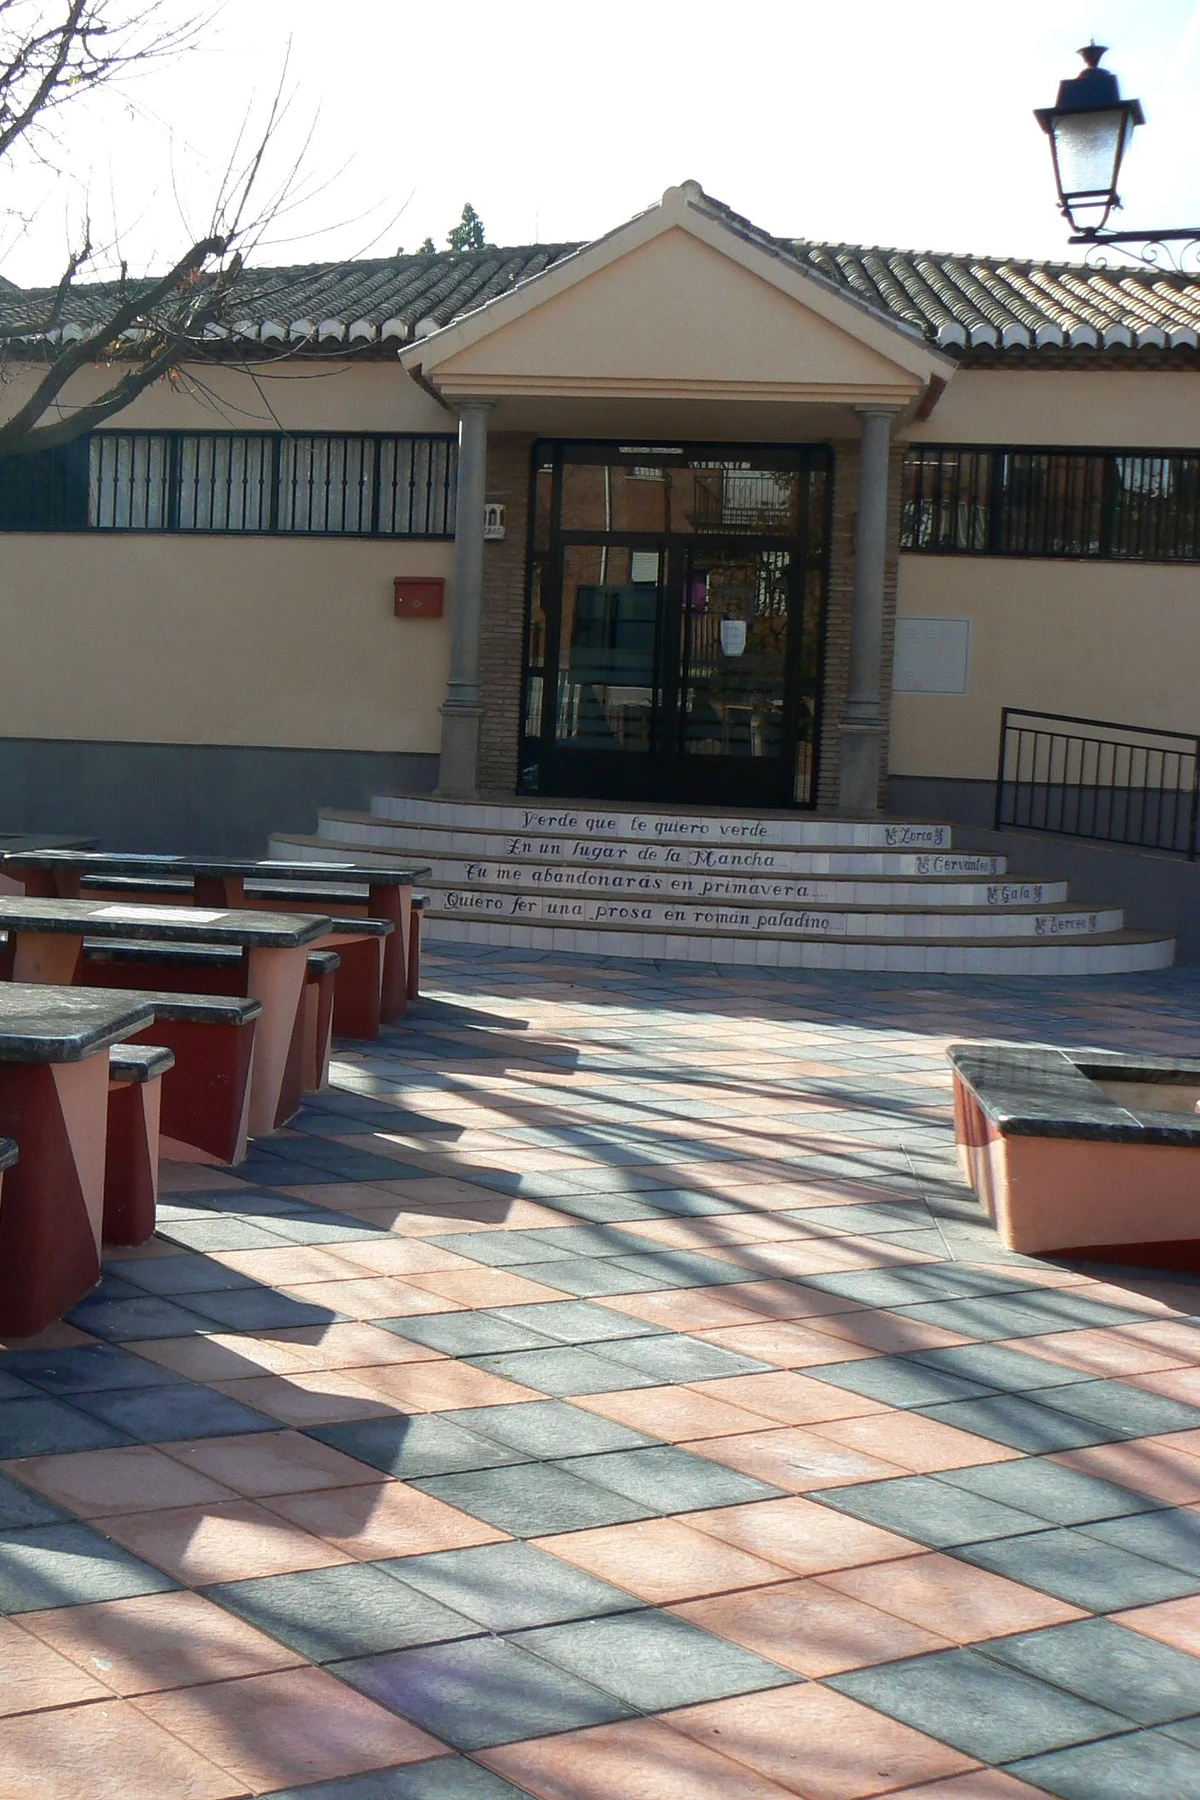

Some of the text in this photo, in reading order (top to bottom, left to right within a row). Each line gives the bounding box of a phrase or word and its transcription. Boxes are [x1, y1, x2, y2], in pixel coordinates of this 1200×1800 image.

[522, 811, 577, 828] Verde
[585, 817, 616, 832] que
[630, 816, 647, 831] te
[655, 821, 709, 836] quiero
[507, 838, 532, 855] En
[539, 843, 561, 855] un
[572, 841, 628, 861] lugar
[638, 847, 657, 861] de
[664, 846, 681, 862] la
[496, 868, 522, 880] me
[532, 868, 662, 890] abandonarás
[671, 879, 694, 891] en
[443, 891, 503, 910] Quiero
[547, 903, 582, 915] una
[589, 904, 652, 921] prosa
[664, 910, 686, 921] en
[693, 910, 750, 925] román
